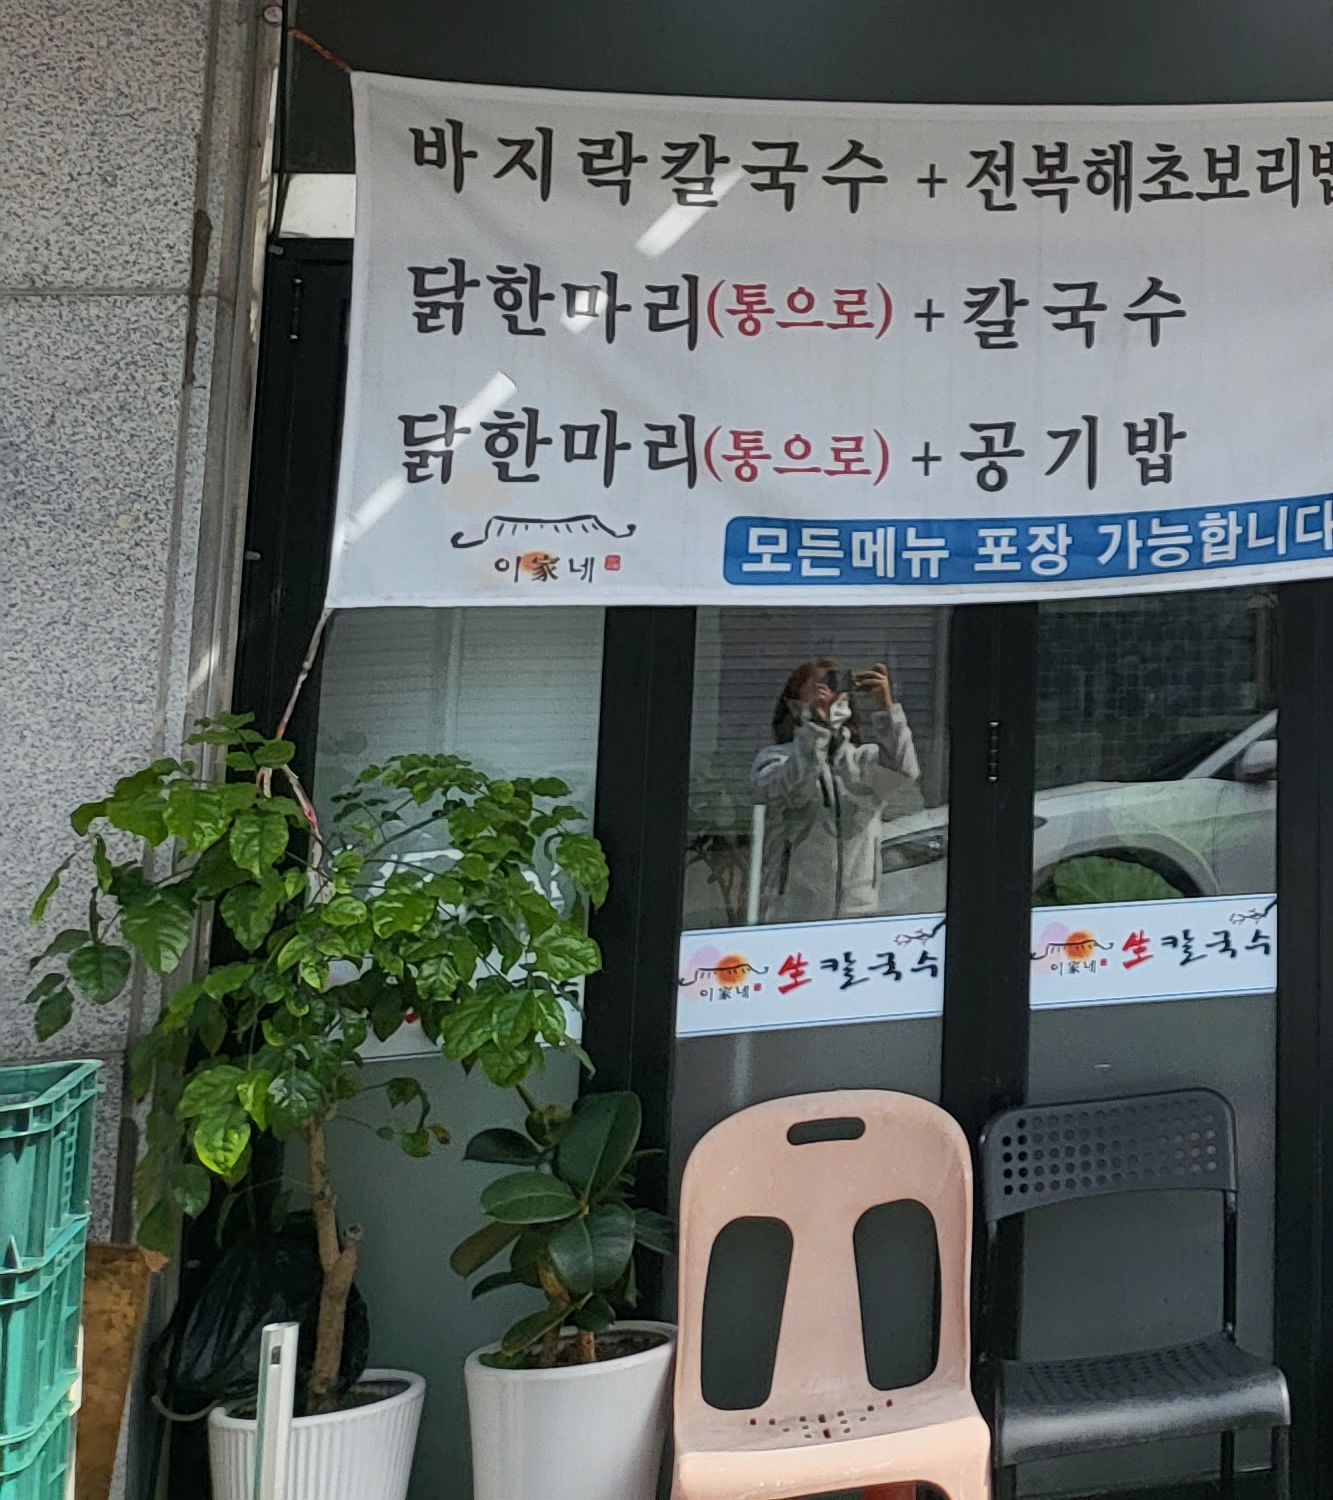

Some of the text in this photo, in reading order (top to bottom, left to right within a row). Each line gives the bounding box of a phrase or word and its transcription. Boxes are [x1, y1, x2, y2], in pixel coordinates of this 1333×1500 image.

[408, 118, 888, 214] 바지락칼국수
[962, 277, 1188, 350] 칼국수
[959, 412, 1187, 491] 공기밥
[494, 555, 596, 583] 이家네
[740, 523, 951, 578] 모든메뉴
[974, 527, 1074, 573] 포장
